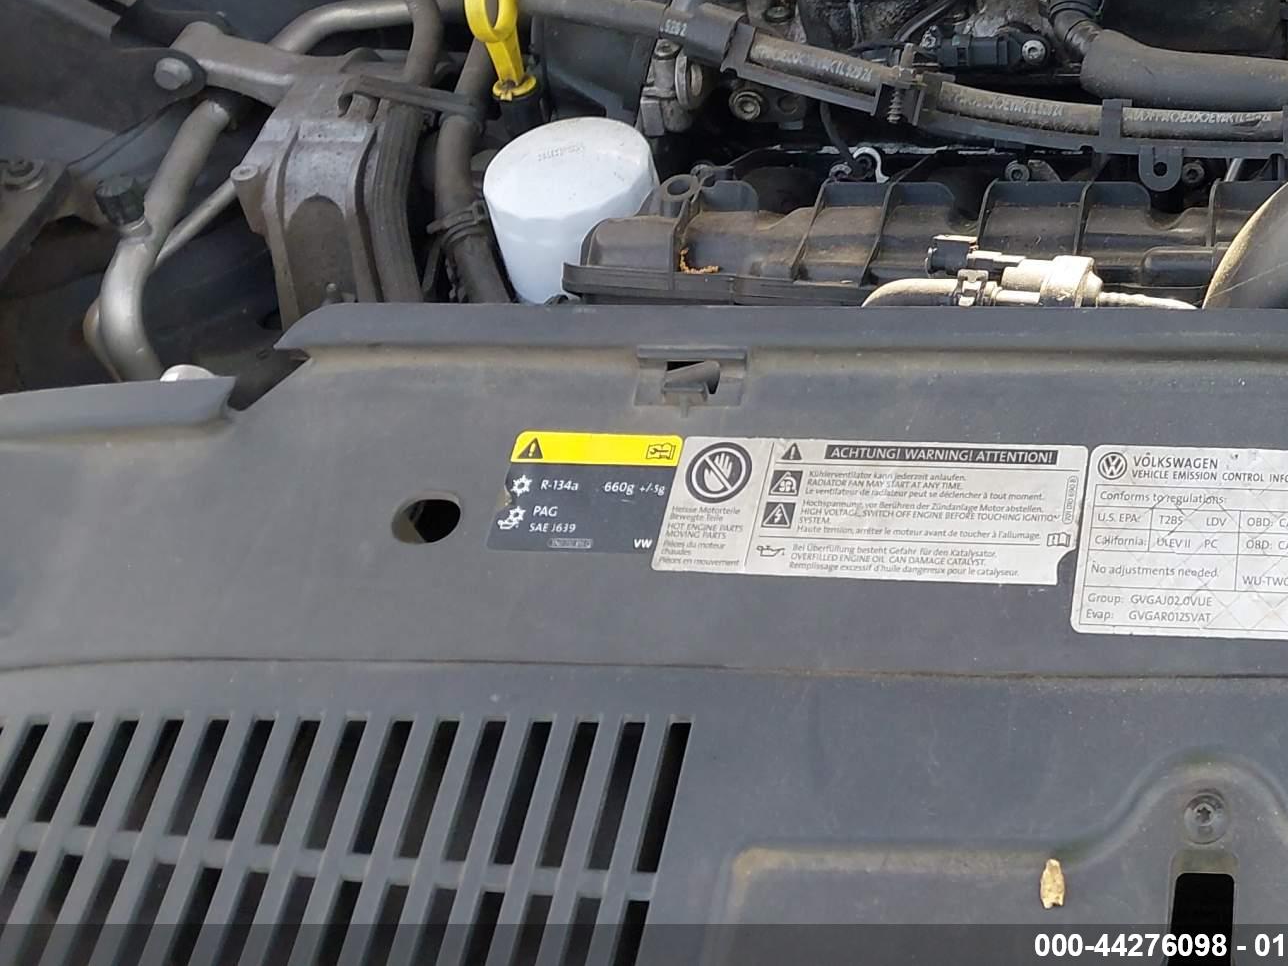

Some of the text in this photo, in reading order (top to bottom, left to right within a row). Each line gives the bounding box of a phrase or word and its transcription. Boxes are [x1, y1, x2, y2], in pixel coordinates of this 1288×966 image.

[831, 447, 1052, 463] ACHTUNG! WARNING! ATTENTION!
[1134, 456, 1218, 469] VOLKSWAGEN
[1132, 470, 1168, 479] VEHICLE
[1173, 470, 1217, 480] EMISSION
[1222, 472, 1264, 482] CONTROL
[540, 480, 665, 496] R-134a 660g +/-5g
[807, 479, 847, 487] RADIATOR
[990, 492, 1006, 500] tout
[1100, 491, 1150, 501] Conforms
[1153, 493, 1164, 501] to
[532, 506, 558, 517] PAG
[801, 508, 822, 516] HIGH
[897, 510, 912, 518] OFF
[913, 511, 943, 519] ENGINE
[980, 504, 1005, 512] Motor
[1098, 512, 1115, 522] U.S.
[1206, 517, 1227, 527] LDV
[1247, 517, 1273, 527] OBD:
[529, 522, 576, 533] SAE J639
[634, 539, 652, 548] VW
[1095, 535, 1147, 547] California:
[1204, 539, 1218, 548] PC
[1246, 539, 1272, 550] OBD:
[791, 553, 838, 561] OVERFILLED
[840, 554, 870, 562] ENGINE
[909, 557, 945, 565] DAMAGE
[1091, 563, 1219, 578] No adjustments needed.
[1088, 593, 1123, 606] Group:
[1086, 609, 1113, 621] Evap:
